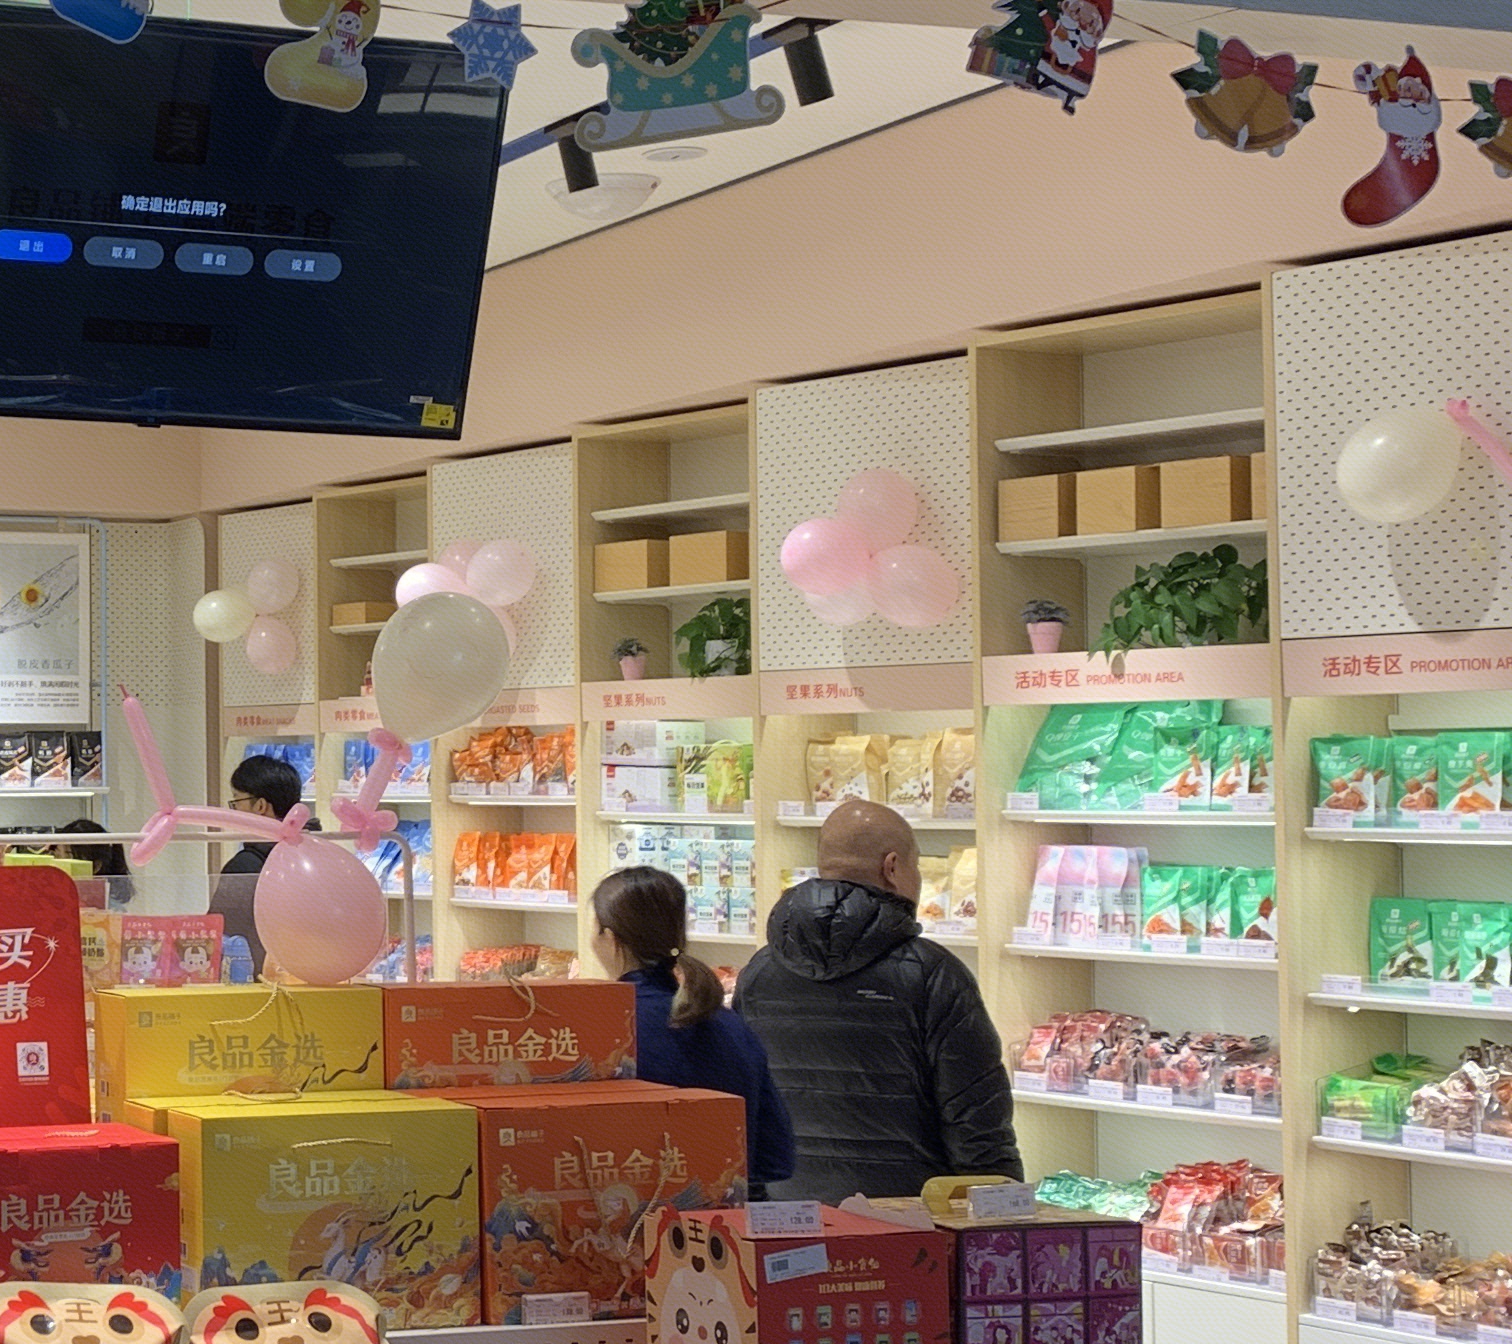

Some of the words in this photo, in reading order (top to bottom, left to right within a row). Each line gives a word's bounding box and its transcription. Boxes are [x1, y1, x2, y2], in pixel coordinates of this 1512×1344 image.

[121, 194, 226, 218] 确定退出应用吗?
[111, 246, 136, 260] 取消
[202, 252, 226, 267] 重启
[291, 259, 316, 273] 设置
[1321, 654, 1403, 678] 活动专区
[1410, 657, 1491, 674] PROMOTION
[1014, 668, 1080, 689] 活动专区
[1086, 672, 1151, 686] PROMOTION
[1154, 671, 1185, 683] AREA
[602, 693, 645, 707] 坚果系列
[645, 696, 666, 706] NUTS
[786, 683, 838, 700] 坚果系列
[839, 686, 865, 697] NUTS
[334, 709, 366, 722] 肉类零食
[366, 711, 382, 721] MEA
[519, 703, 540, 713] SEEDS
[188, 1031, 325, 1073] 良品金选
[451, 1025, 580, 1064] 良品金选
[554, 1147, 688, 1190] 良品金选
[0, 1189, 133, 1233] 良品金选
